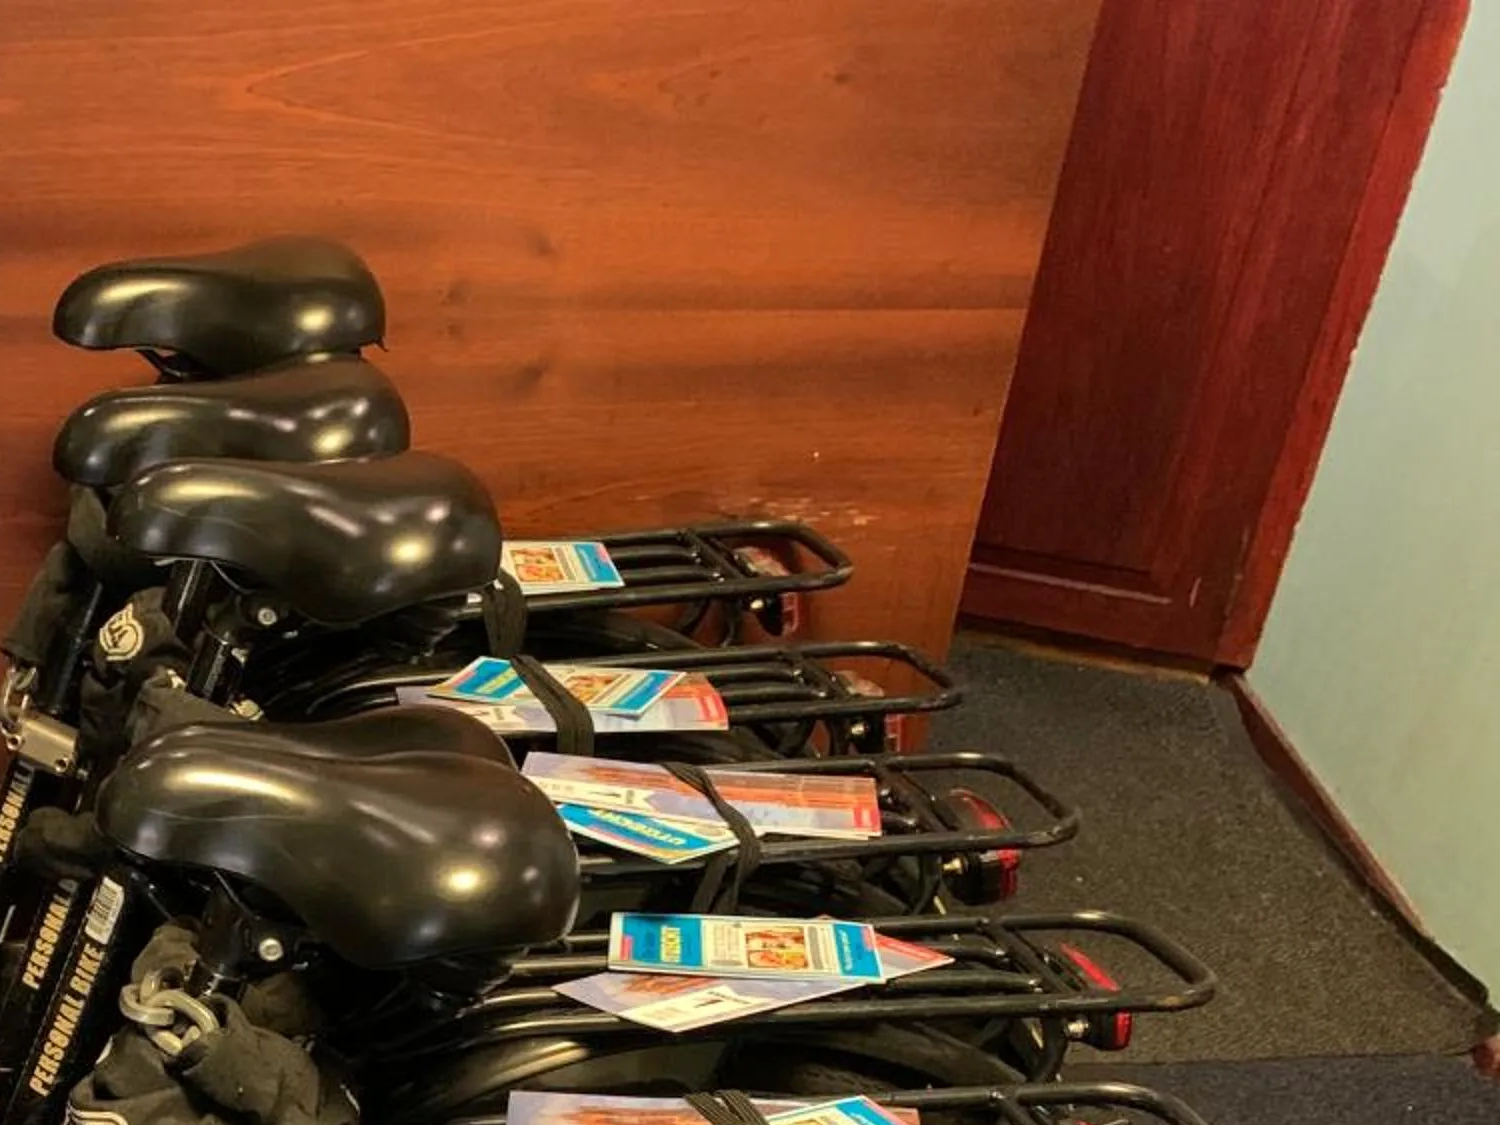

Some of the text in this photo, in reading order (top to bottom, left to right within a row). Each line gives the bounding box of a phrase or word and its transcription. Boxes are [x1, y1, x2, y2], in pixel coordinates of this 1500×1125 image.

[22, 893, 73, 990] PERSONAL
[29, 993, 85, 1097] PERSONAL
[69, 942, 105, 997] BIKE
